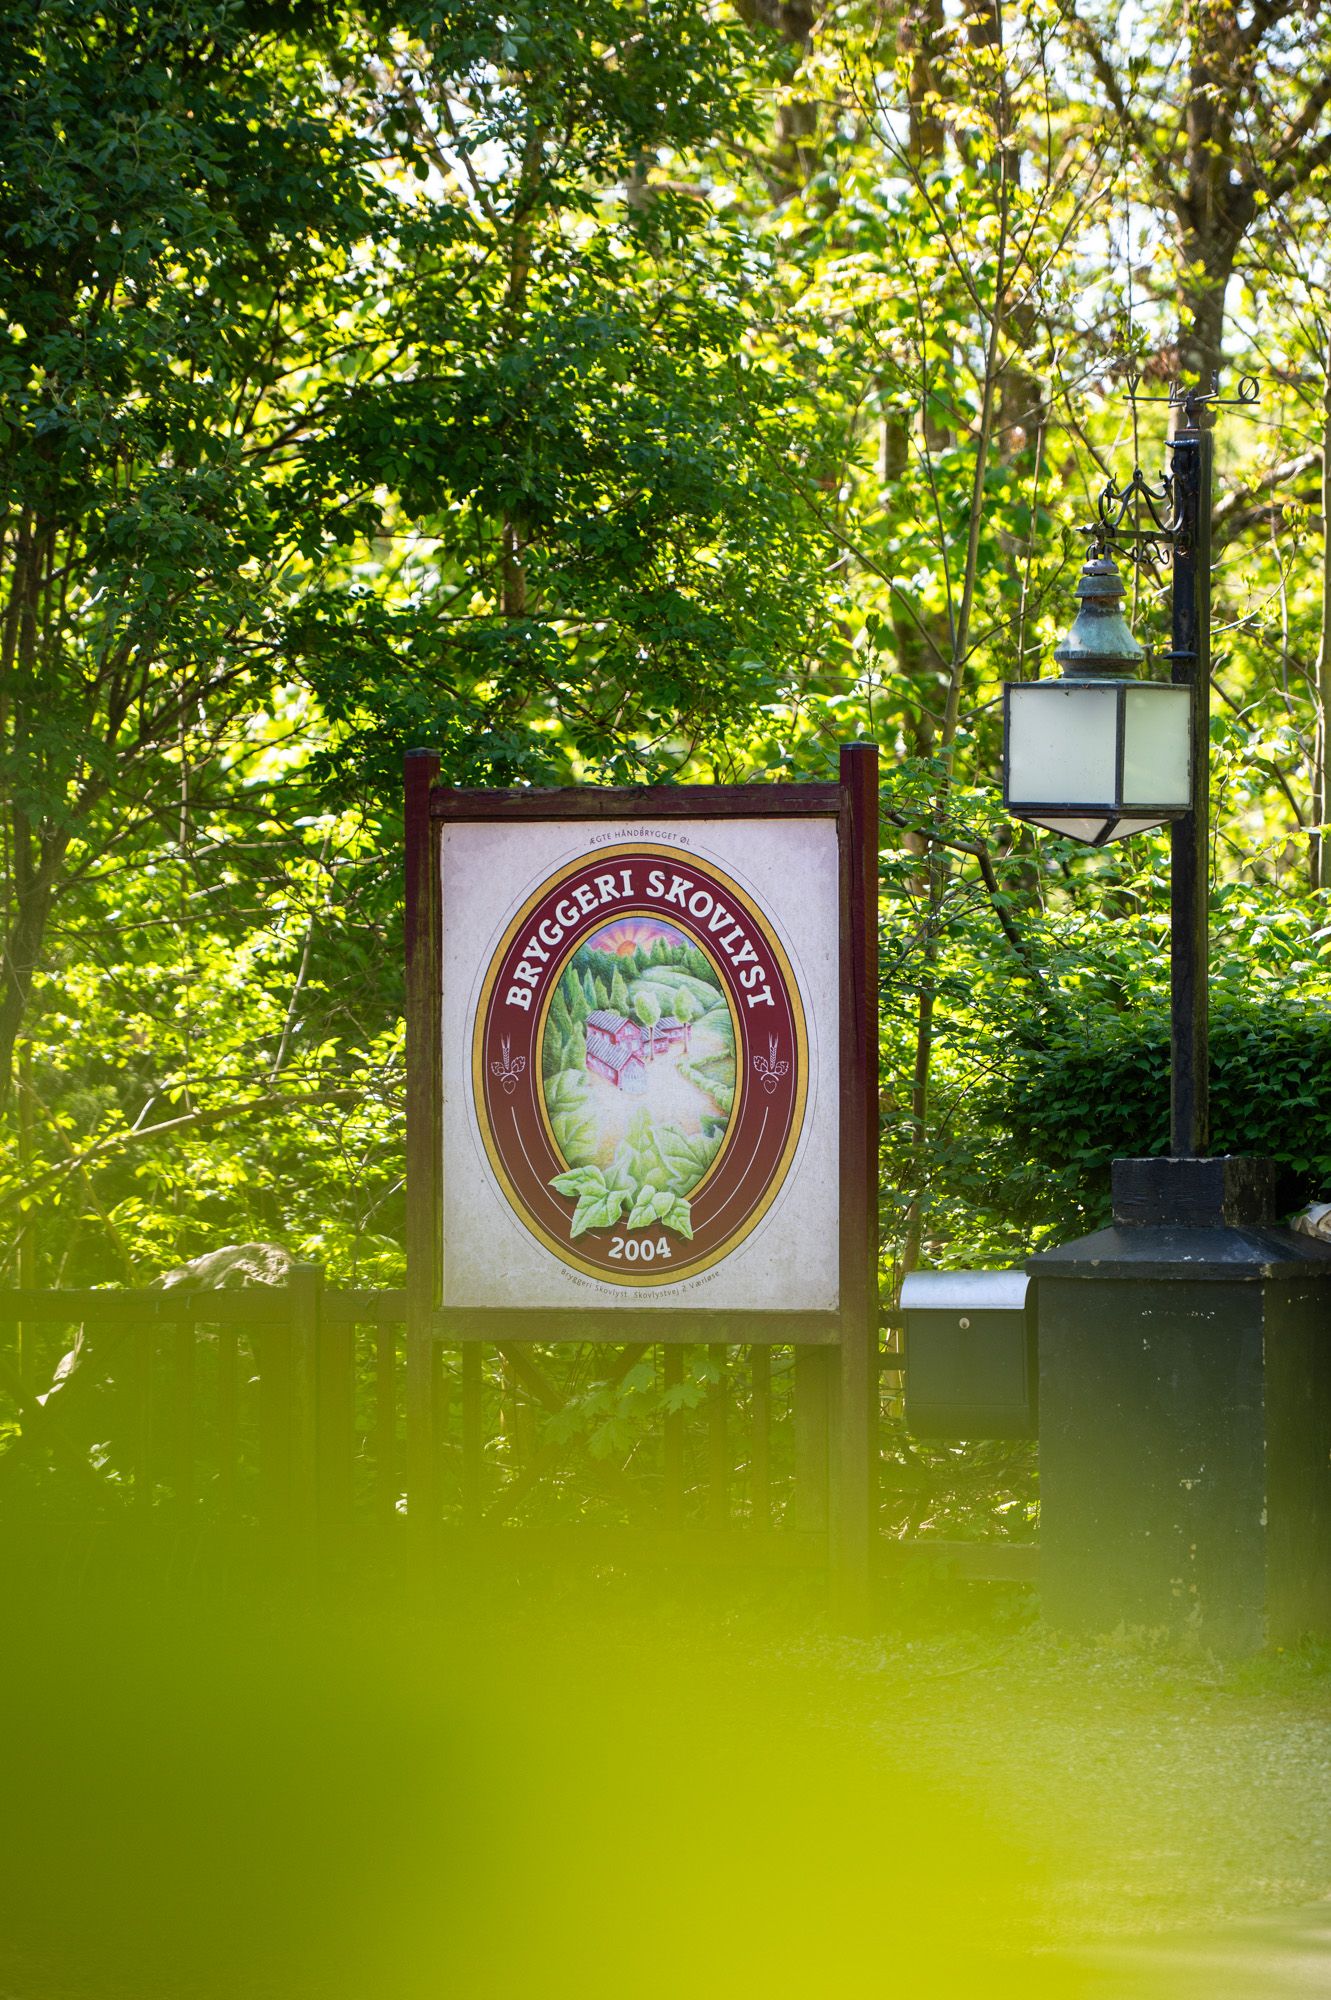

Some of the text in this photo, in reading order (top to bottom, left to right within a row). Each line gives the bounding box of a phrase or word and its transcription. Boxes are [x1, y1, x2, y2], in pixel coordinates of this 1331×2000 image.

[589, 829, 691, 846] ÆGTE HÅNDBRYGGET ØL
[505, 869, 775, 1011] BRYGGERI SKOVLYST
[608, 1236, 672, 1262] 2004
[560, 1268, 593, 1289] Bryggeri
[594, 1284, 628, 1298] Skovlyst
[633, 1288, 680, 1300] Skovlystvej
[688, 1270, 720, 1289] Værløse
